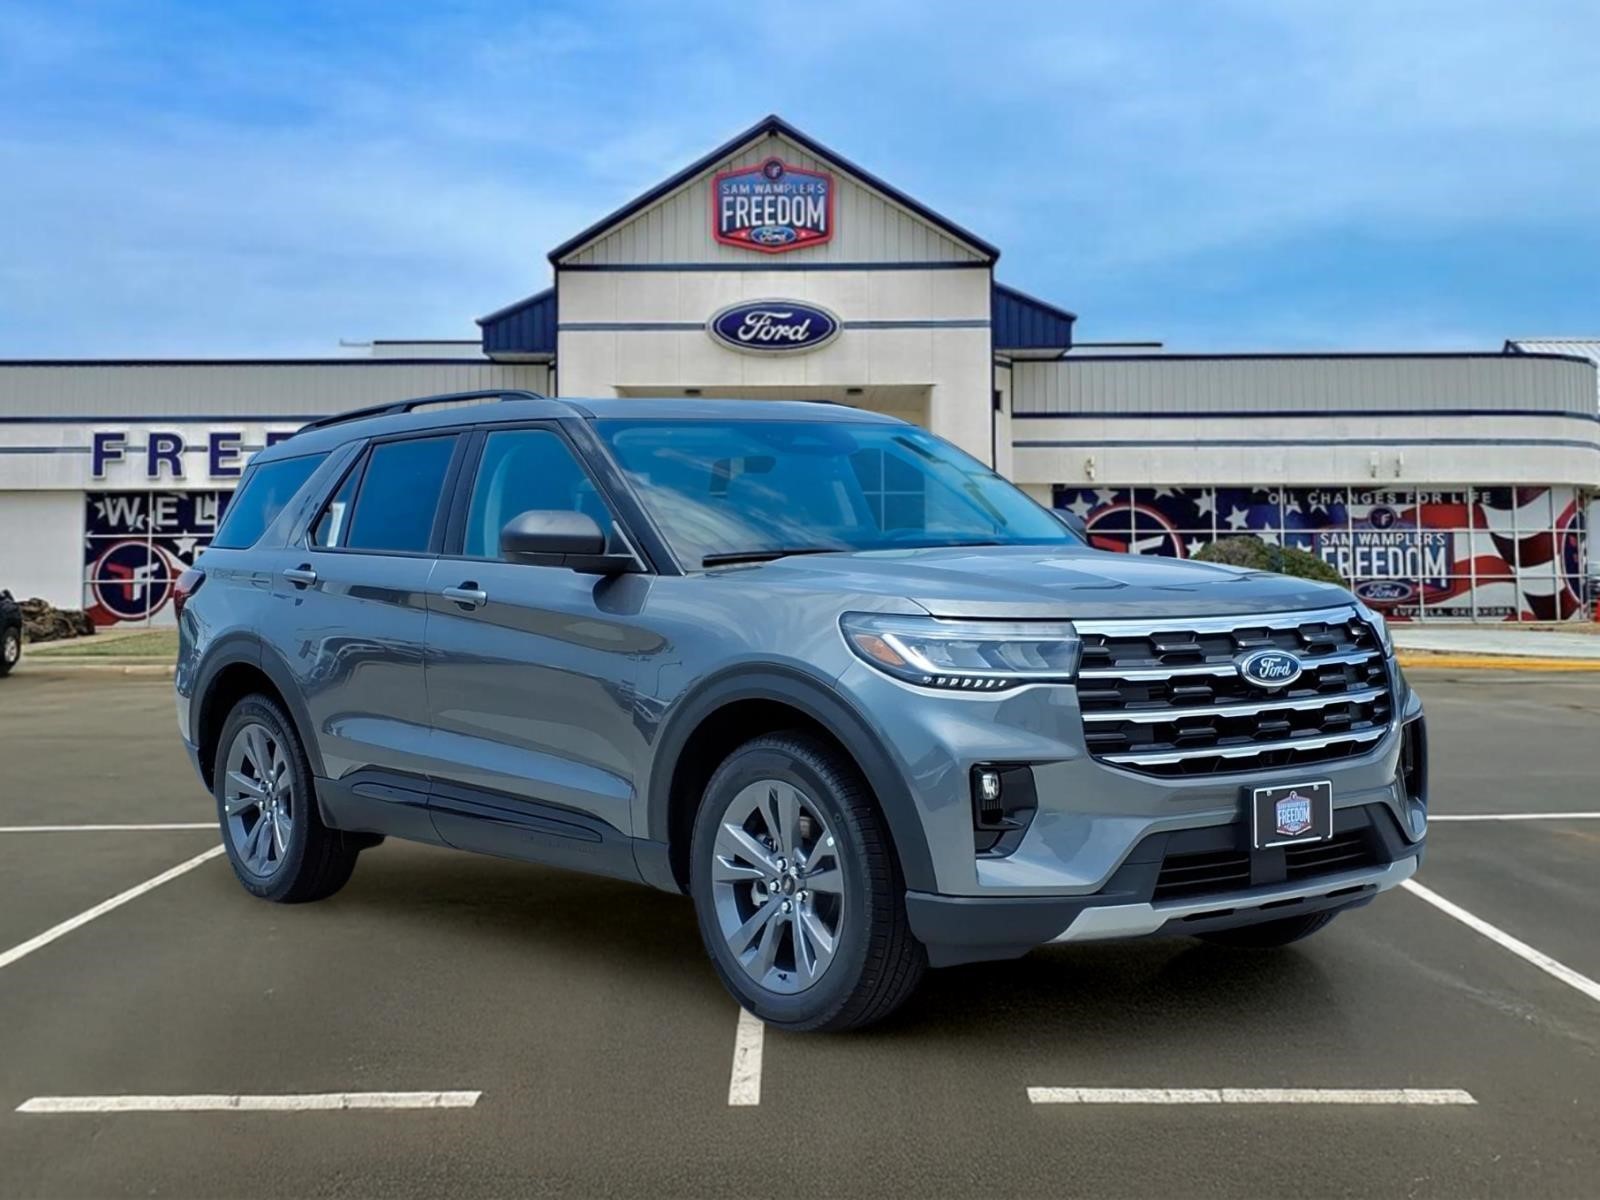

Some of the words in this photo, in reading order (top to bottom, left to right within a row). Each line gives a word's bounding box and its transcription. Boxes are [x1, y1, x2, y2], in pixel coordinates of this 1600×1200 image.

[722, 184, 749, 194] SAM
[722, 196, 825, 232] FREEDOM
[759, 227, 787, 242] Ford
[738, 311, 811, 341] Ford
[1268, 492, 1299, 504] OIL
[1307, 492, 1397, 504] CHANGES
[1406, 491, 1442, 504] FOR
[1451, 491, 1491, 504] LIFE
[1365, 584, 1401, 598] Ford
[1452, 608, 1512, 617] OKLAHOMA
[1259, 657, 1291, 678] Ford
[1277, 807, 1311, 828] FREEDOM
